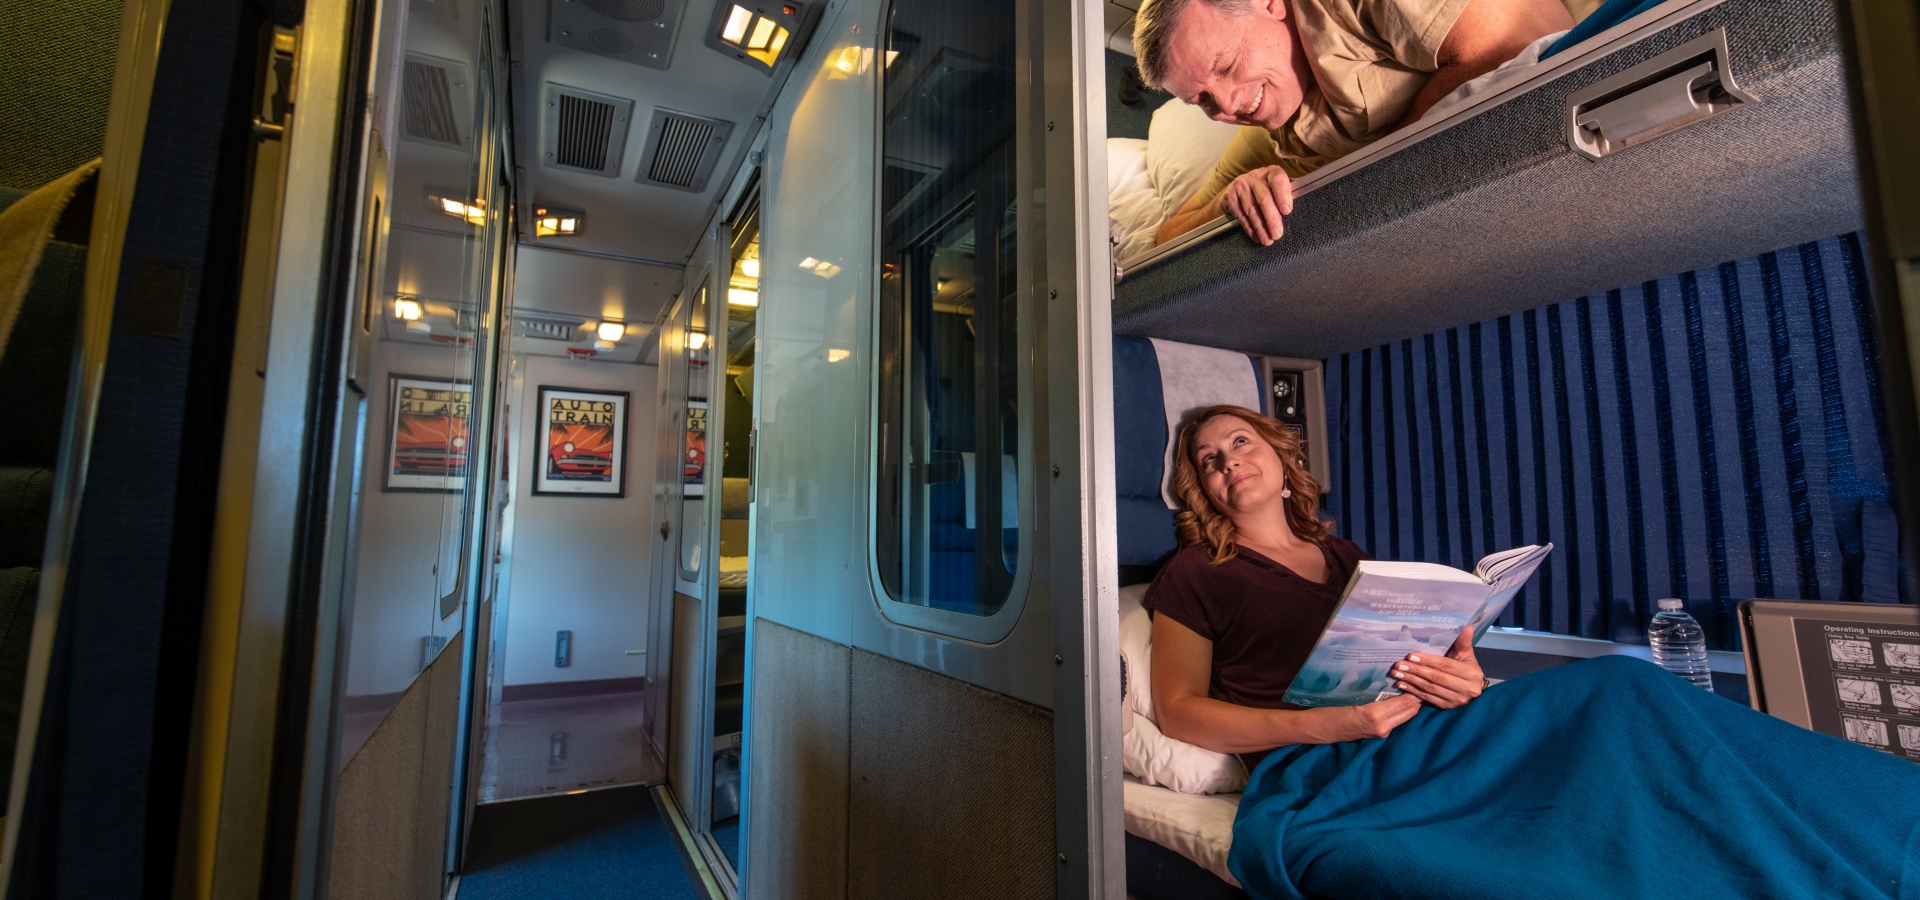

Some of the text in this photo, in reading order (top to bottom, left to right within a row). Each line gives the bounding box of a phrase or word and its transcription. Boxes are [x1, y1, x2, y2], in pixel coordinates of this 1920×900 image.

[553, 400, 613, 412] AUTO
[553, 410, 613, 424] TRAIN
[1823, 624, 1920, 637] Operating Instructions
